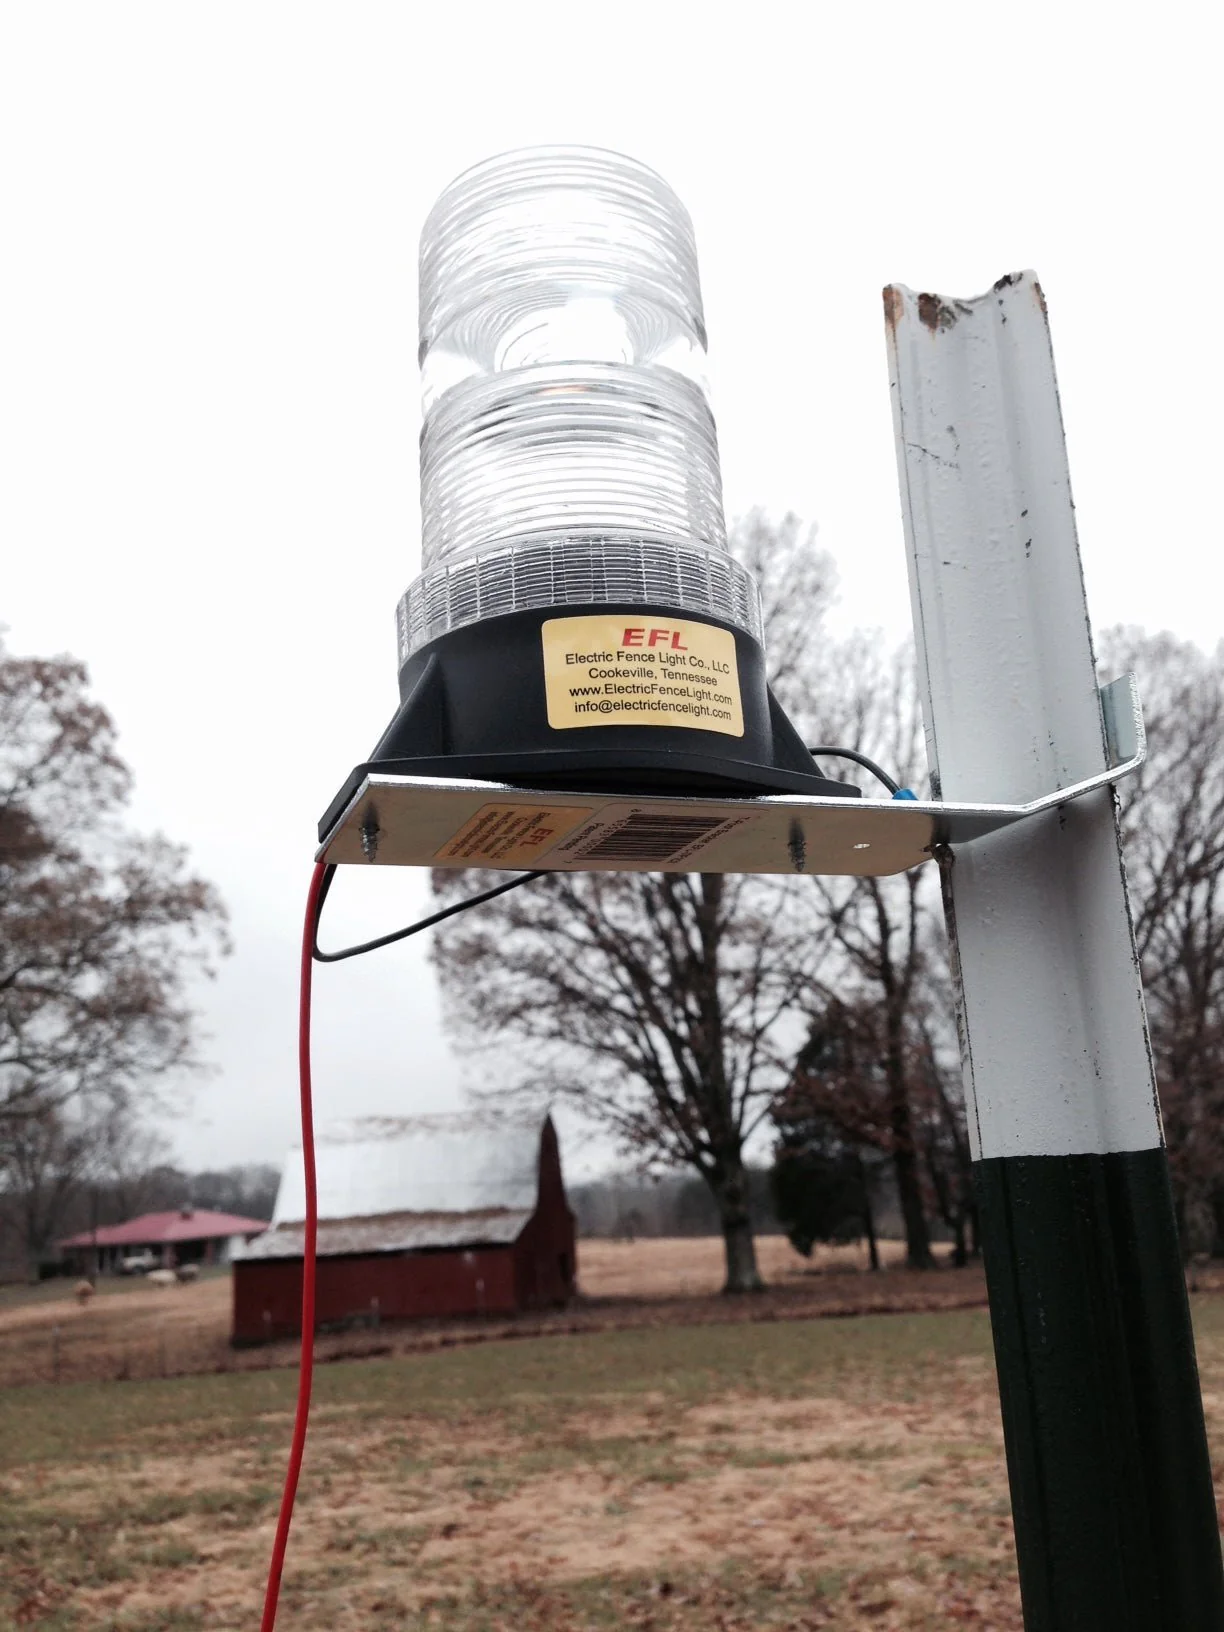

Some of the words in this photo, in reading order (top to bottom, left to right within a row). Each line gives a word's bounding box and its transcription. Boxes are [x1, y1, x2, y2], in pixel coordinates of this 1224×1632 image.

[622, 628, 688, 651] EFL
[565, 652, 614, 665] Electric
[617, 651, 655, 662] Fence
[659, 652, 686, 667] Light
[689, 656, 710, 670] Co.,
[712, 660, 730, 674] LLC
[588, 667, 658, 680] Cookeville,
[660, 668, 718, 686] Tennessee
[569, 683, 733, 705] www.ElectricFenceLight.com
[574, 699, 732, 720] info@electricfencelight.com
[519, 828, 555, 847] EFL
